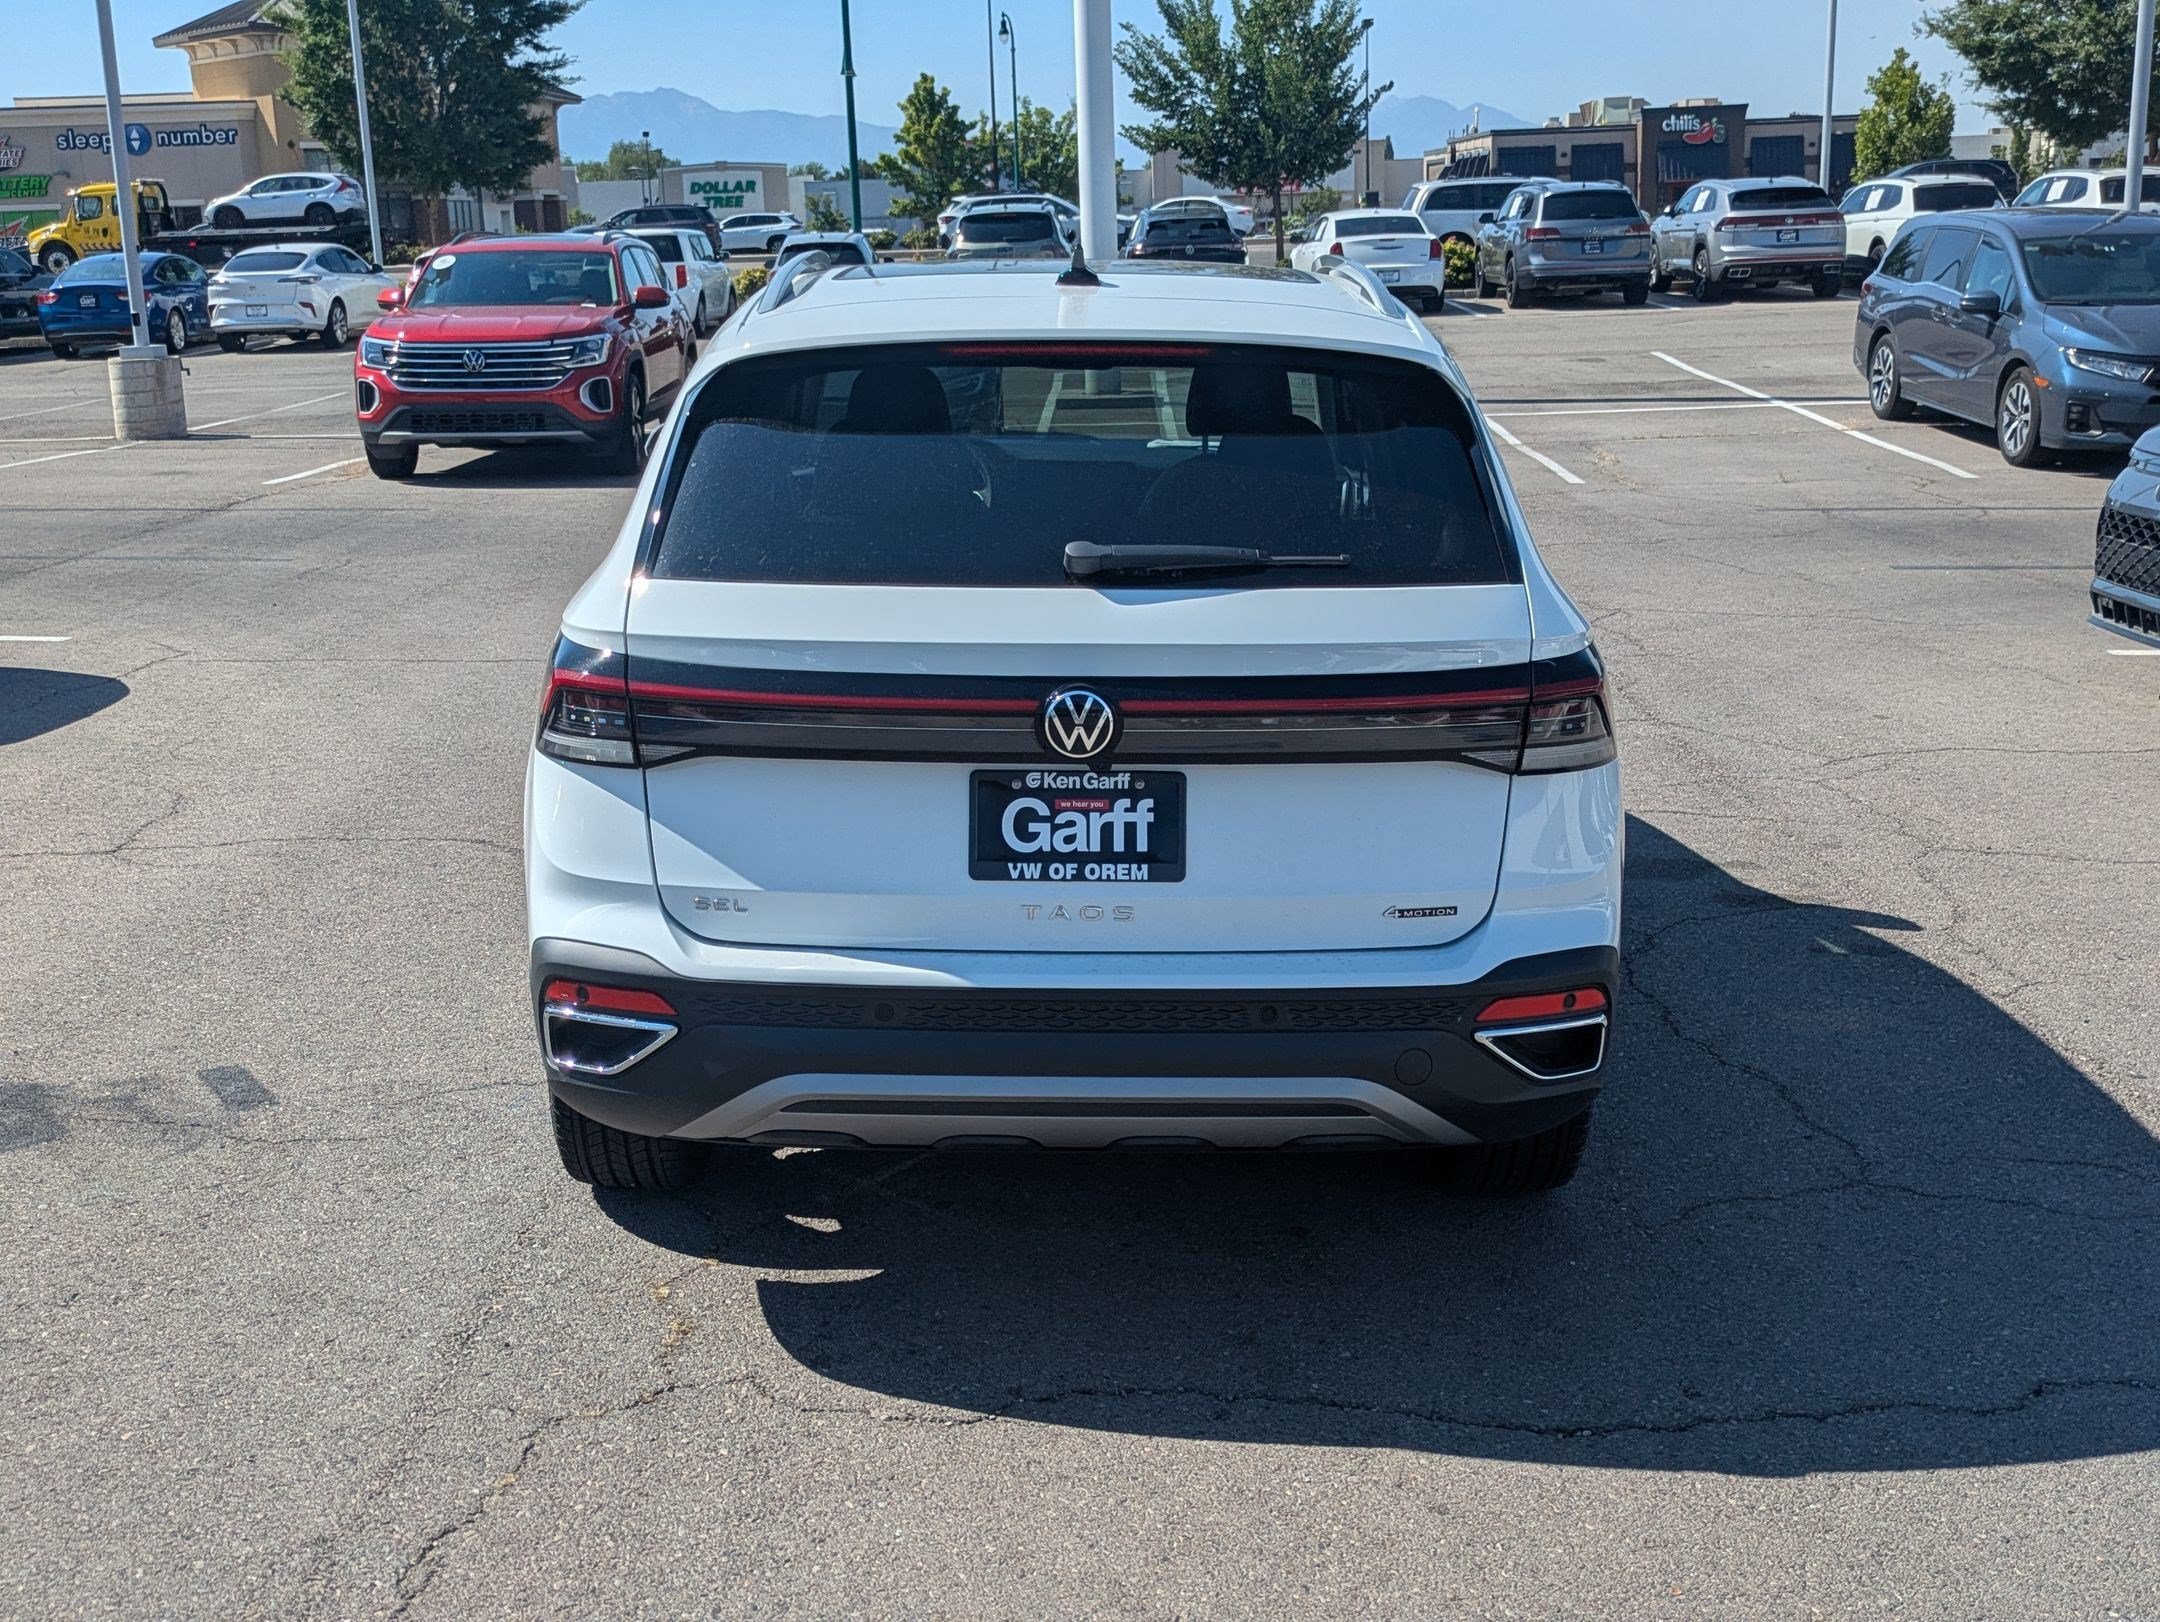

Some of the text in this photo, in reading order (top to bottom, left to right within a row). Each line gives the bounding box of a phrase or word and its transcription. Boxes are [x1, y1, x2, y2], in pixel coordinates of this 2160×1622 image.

[57, 125, 237, 153] sleep number
[10, 189, 47, 198] CENTER
[690, 180, 756, 195] DOLLAR
[703, 195, 744, 208] TREE
[1043, 772, 1131, 790] Ken Garff
[1072, 800, 1089, 808] hear
[1090, 801, 1104, 809] you
[1001, 797, 1155, 853] Garff
[1007, 862, 1149, 881] VW OF OREM
[693, 896, 749, 912] SEL
[1020, 904, 1136, 921] TAOS
